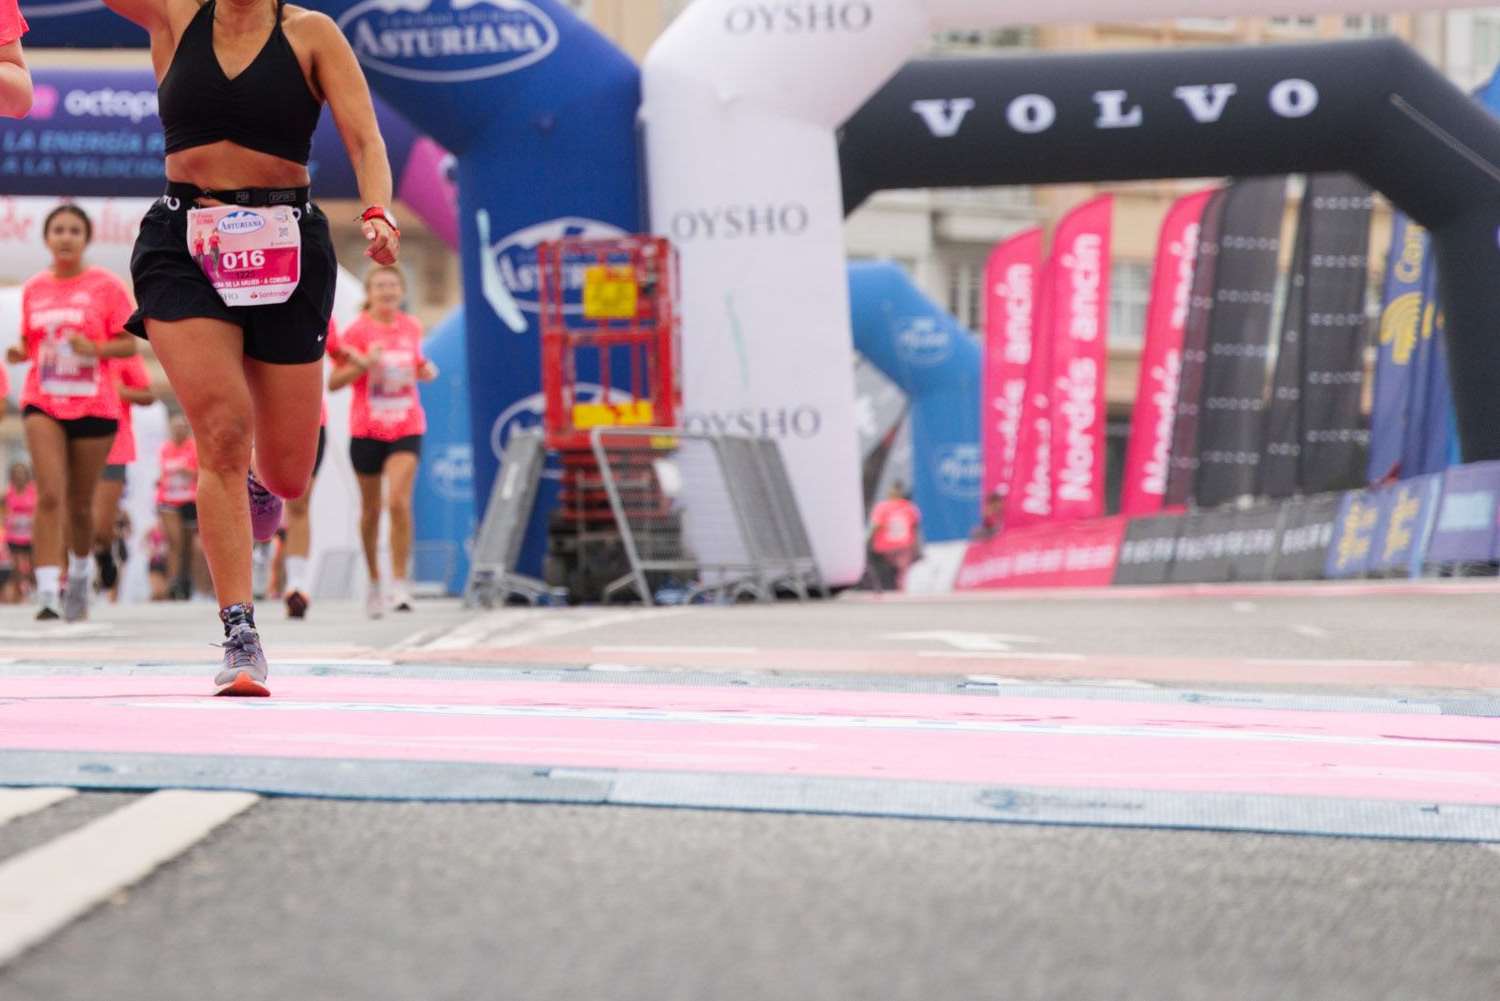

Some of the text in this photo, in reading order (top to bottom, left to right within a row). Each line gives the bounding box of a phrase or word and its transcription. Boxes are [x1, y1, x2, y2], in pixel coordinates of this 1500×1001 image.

[725, 0, 872, 35] OYSHO
[355, 17, 544, 58] ASTURIANA
[911, 77, 1320, 139] VOLVO
[221, 219, 263, 231] ASTURIANA
[672, 202, 810, 240] OYSHO
[222, 250, 265, 270] 016
[1058, 356, 1097, 502] Nordés
